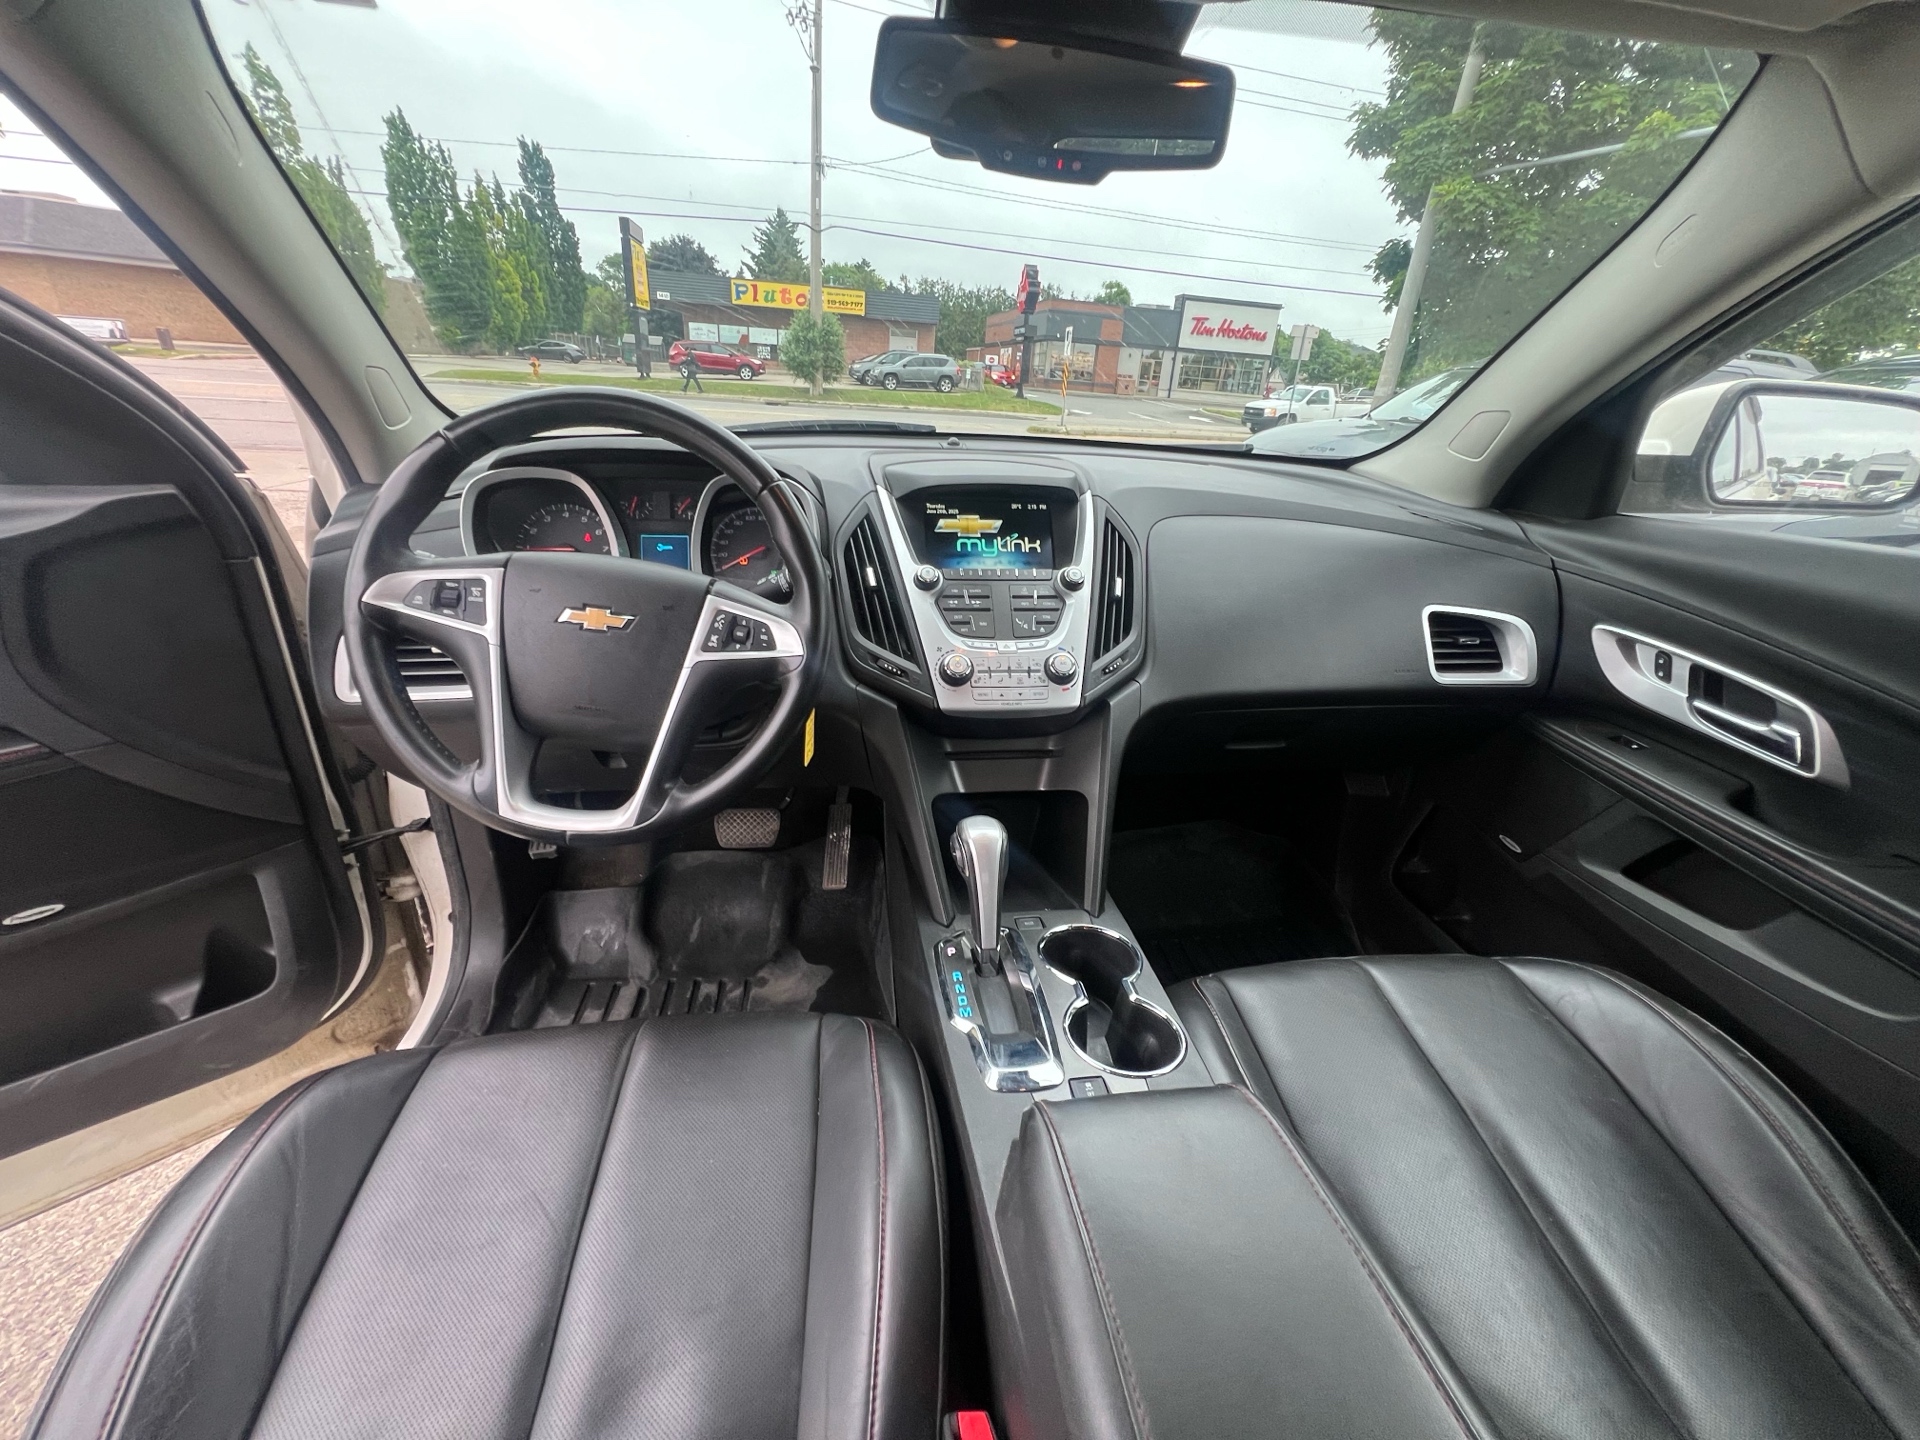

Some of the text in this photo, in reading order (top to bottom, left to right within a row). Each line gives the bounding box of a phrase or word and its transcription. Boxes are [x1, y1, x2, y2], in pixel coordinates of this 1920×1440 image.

[1190, 316, 1268, 342] Tim Hortons
[956, 533, 1042, 557] mylink
[947, 946, 956, 957] P
[952, 971, 962, 982] R
[955, 984, 965, 994] N
[957, 995, 968, 1006] D
[959, 1007, 972, 1018] M
